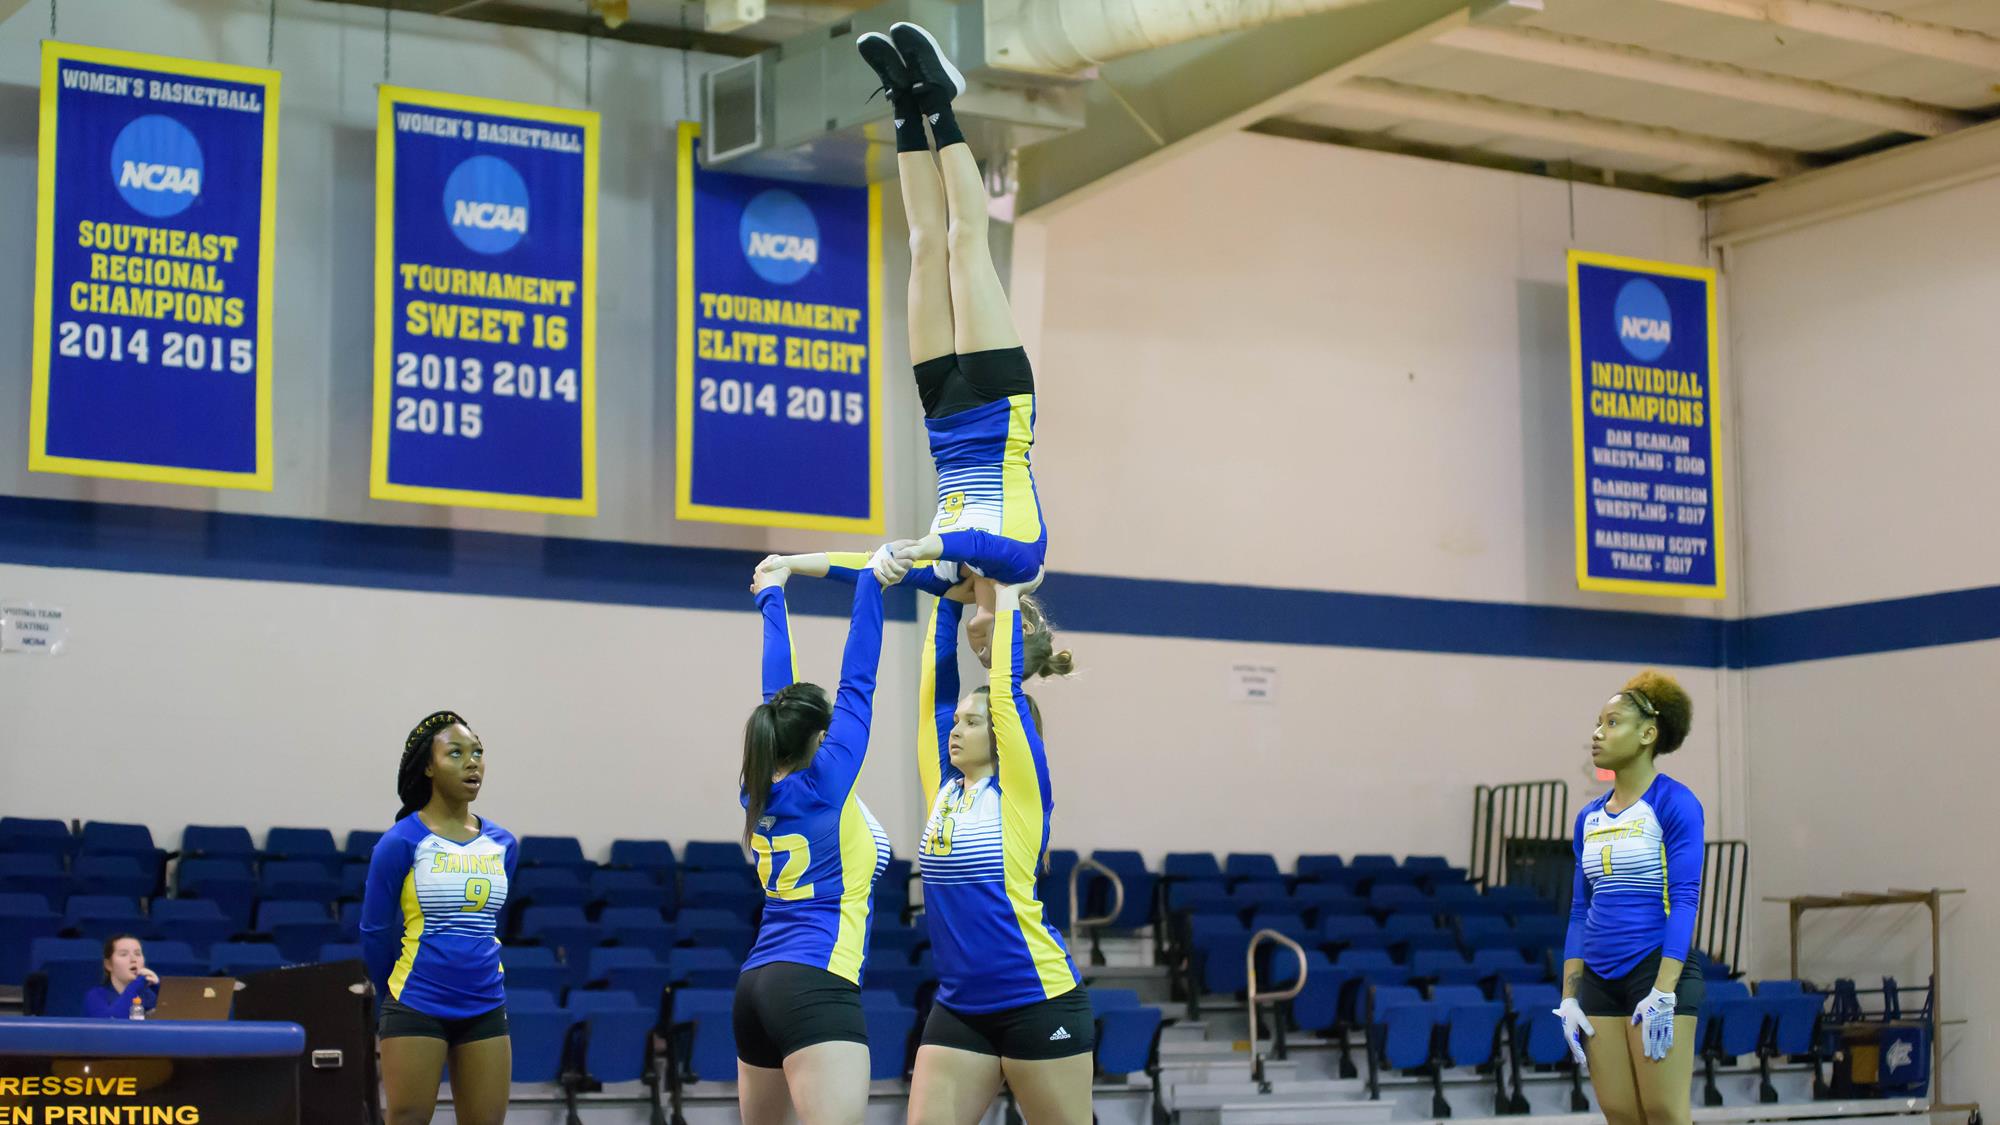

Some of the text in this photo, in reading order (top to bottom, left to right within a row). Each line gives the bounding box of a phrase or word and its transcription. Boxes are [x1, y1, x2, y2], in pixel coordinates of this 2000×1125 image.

[62, 68, 261, 112] WOMEN'S BASKETBALL
[397, 111, 581, 152] WOMEN'S BASKETBALL
[119, 160, 200, 196] NCAA
[452, 200, 528, 234] NCAA
[78, 220, 239, 263] SOUTHEAST
[748, 231, 818, 264] NCAA
[91, 253, 224, 293] REGIONAL
[400, 263, 576, 306] TOURNAMENT
[69, 281, 245, 328] CHAMPIONS
[700, 293, 860, 333] TOURNAMENT
[405, 300, 568, 350] SWEET 16
[1621, 315, 1672, 343] NCAA
[59, 321, 253, 374] 2014 2015
[698, 328, 866, 375] ELITE EIGHT
[396, 352, 578, 402] 2013 2014
[1591, 361, 1703, 397] INDIVIDUAL
[396, 397, 483, 438] 2015
[700, 377, 863, 425] 2014 2015
[1591, 390, 1703, 427] CHAMPIONS
[1606, 429, 1632, 447] DAN
[1592, 446, 1664, 471] WRESTLING
[1595, 498, 1667, 522] WRESTLING
[1677, 506, 1706, 525] 2017
[1654, 483, 1708, 505] JOHNSON
[1611, 551, 1653, 572] TRACK
[1664, 555, 1692, 575] 2017
[1668, 536, 1707, 556] SCOTT
[431, 852, 504, 876] SAINTS
[1600, 844, 1613, 876] 1
[460, 877, 492, 912] 9
[0, 1076, 138, 1096] RESSIVE
[45, 1105, 200, 1125] PRINTING
